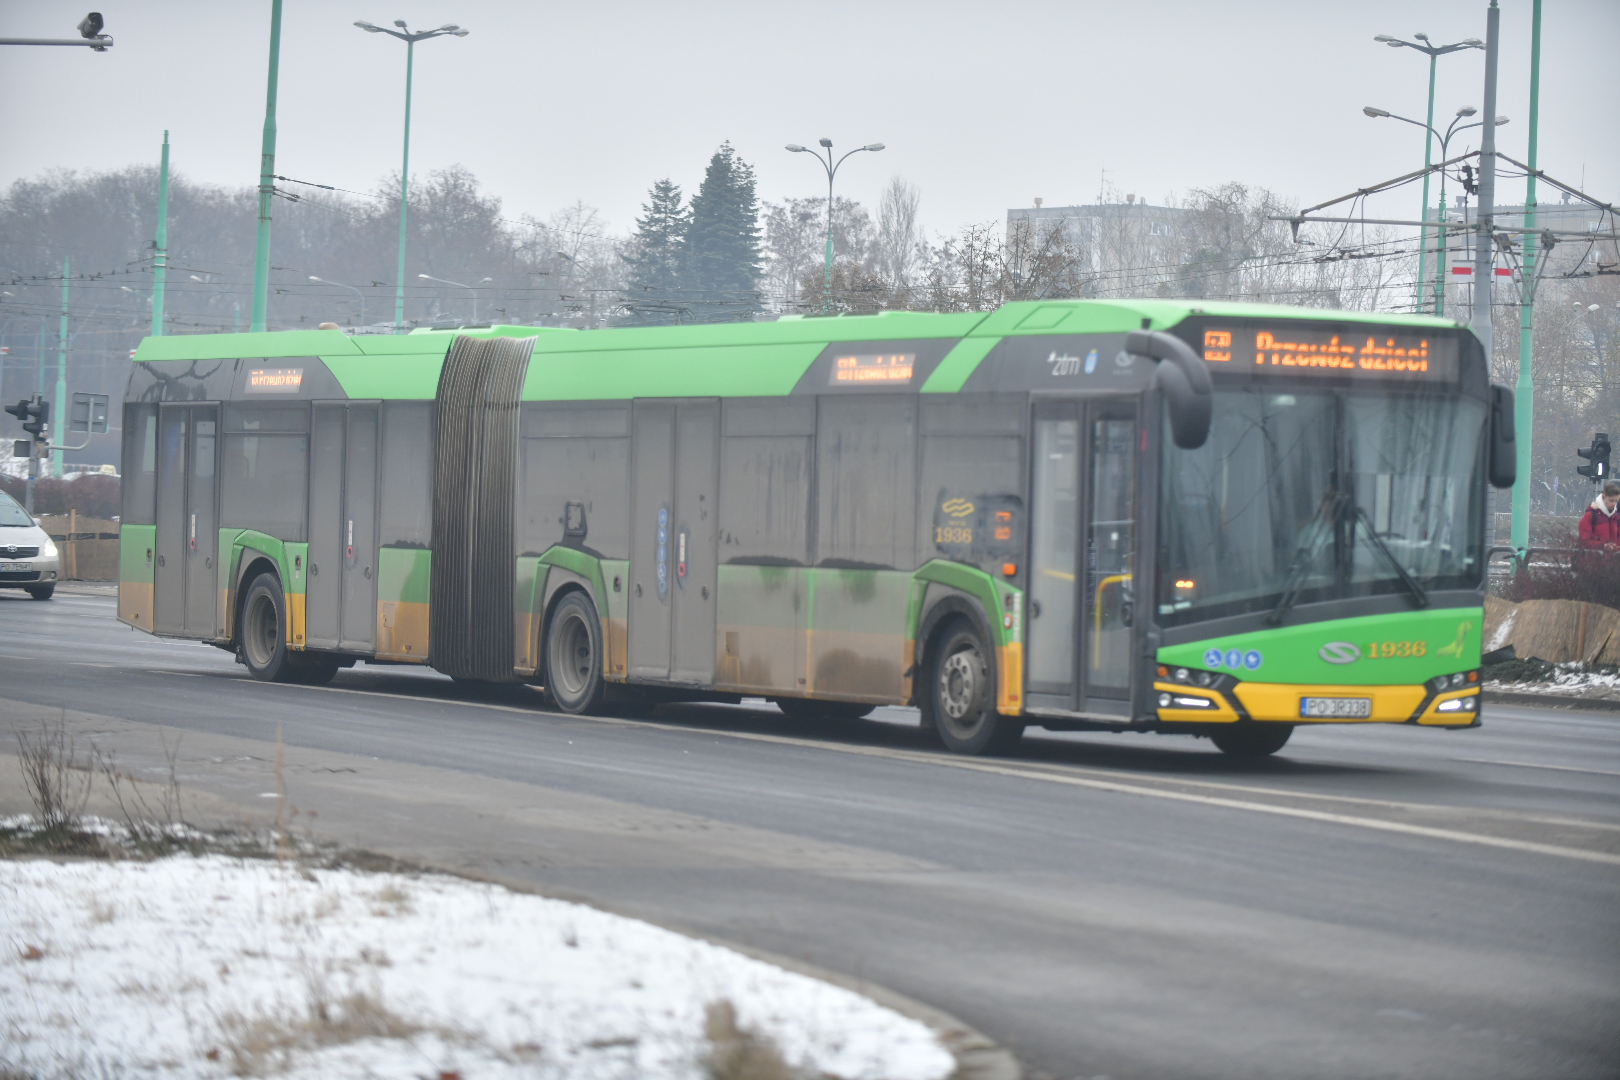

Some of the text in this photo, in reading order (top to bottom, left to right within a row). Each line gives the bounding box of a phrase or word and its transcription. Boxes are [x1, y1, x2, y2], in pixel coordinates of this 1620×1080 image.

[935, 527, 973, 544] 1936
[1, 563, 11, 571] PO
[1367, 640, 1427, 659] 1936
[1308, 699, 1367, 716] PO 3R338
